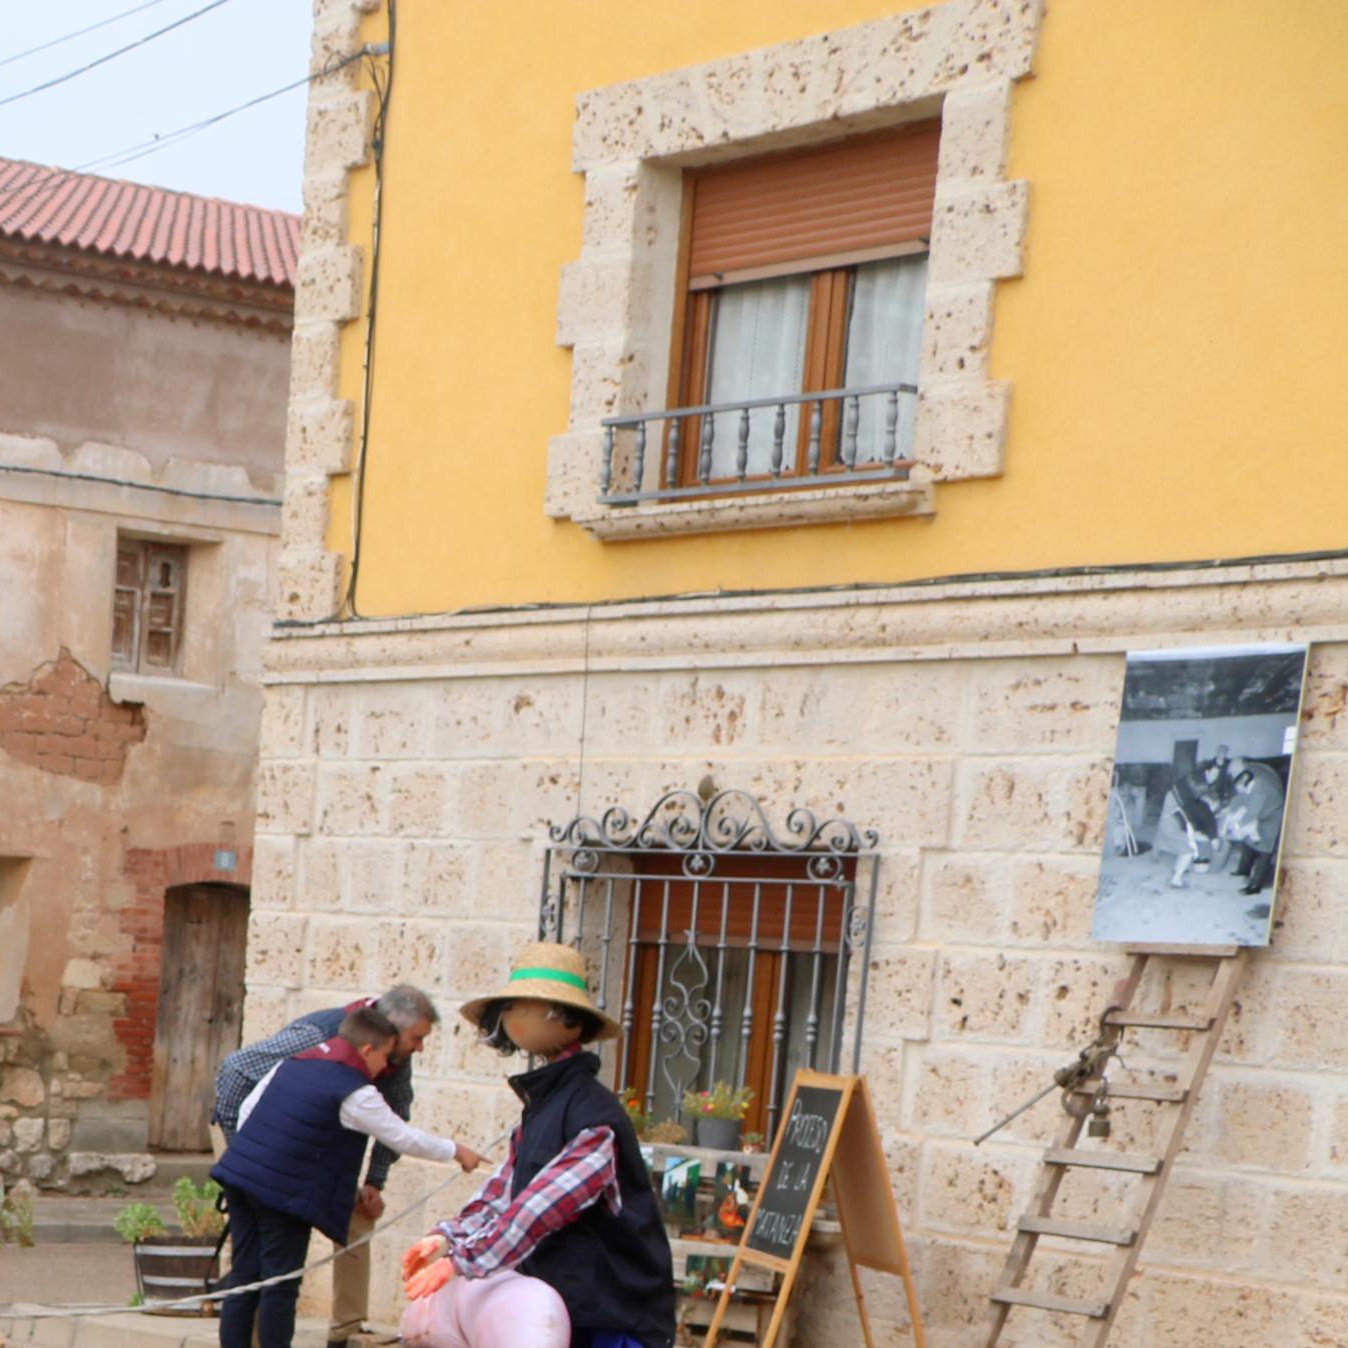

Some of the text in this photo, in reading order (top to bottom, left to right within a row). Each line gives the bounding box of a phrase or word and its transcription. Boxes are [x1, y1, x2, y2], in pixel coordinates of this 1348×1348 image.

[777, 1160, 811, 1191] DE LA
[752, 1207, 802, 1245] MATANZA
